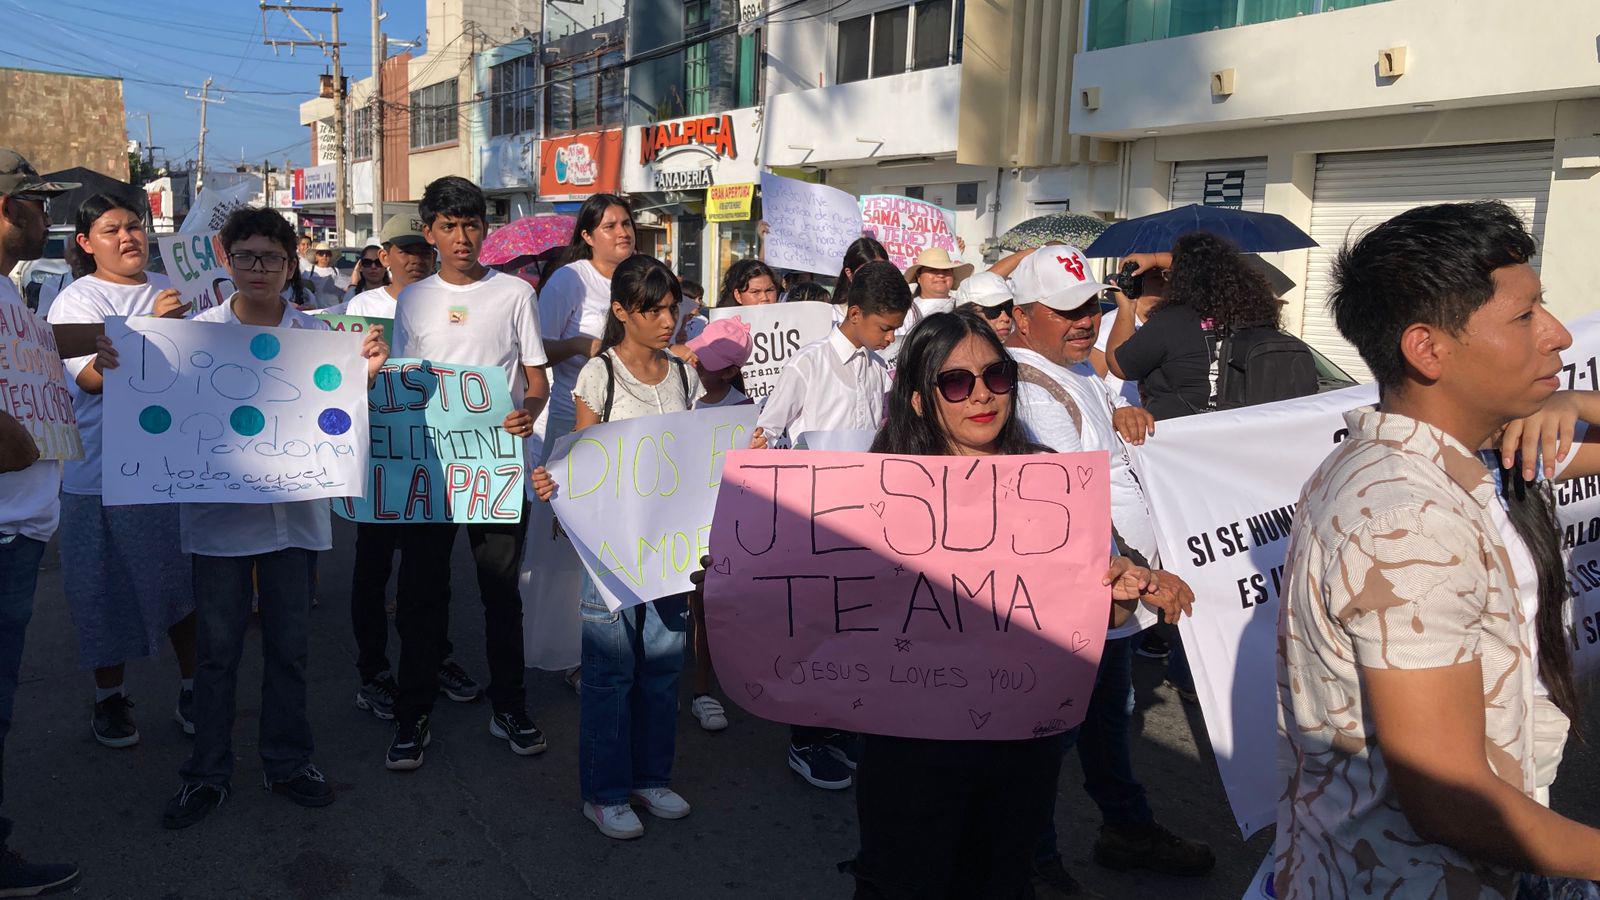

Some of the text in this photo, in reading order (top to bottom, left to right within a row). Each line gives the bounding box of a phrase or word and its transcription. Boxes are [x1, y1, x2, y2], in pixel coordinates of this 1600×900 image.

[640, 115, 737, 166] MALPICA
[865, 197, 944, 221] JESUCRISTO
[172, 241, 200, 281] EL
[901, 228, 927, 247] DES
[931, 232, 955, 253] POR
[164, 456, 231, 481] todo
[567, 430, 681, 500] DIOS
[374, 463, 523, 521] LA PAZ
[735, 458, 1071, 557] JESÚS
[1187, 532, 1217, 568] SI
[1215, 521, 1250, 558] SE
[752, 569, 1043, 638] TE AMA
[1236, 573, 1269, 610] ES
[889, 664, 970, 690] LOVES
